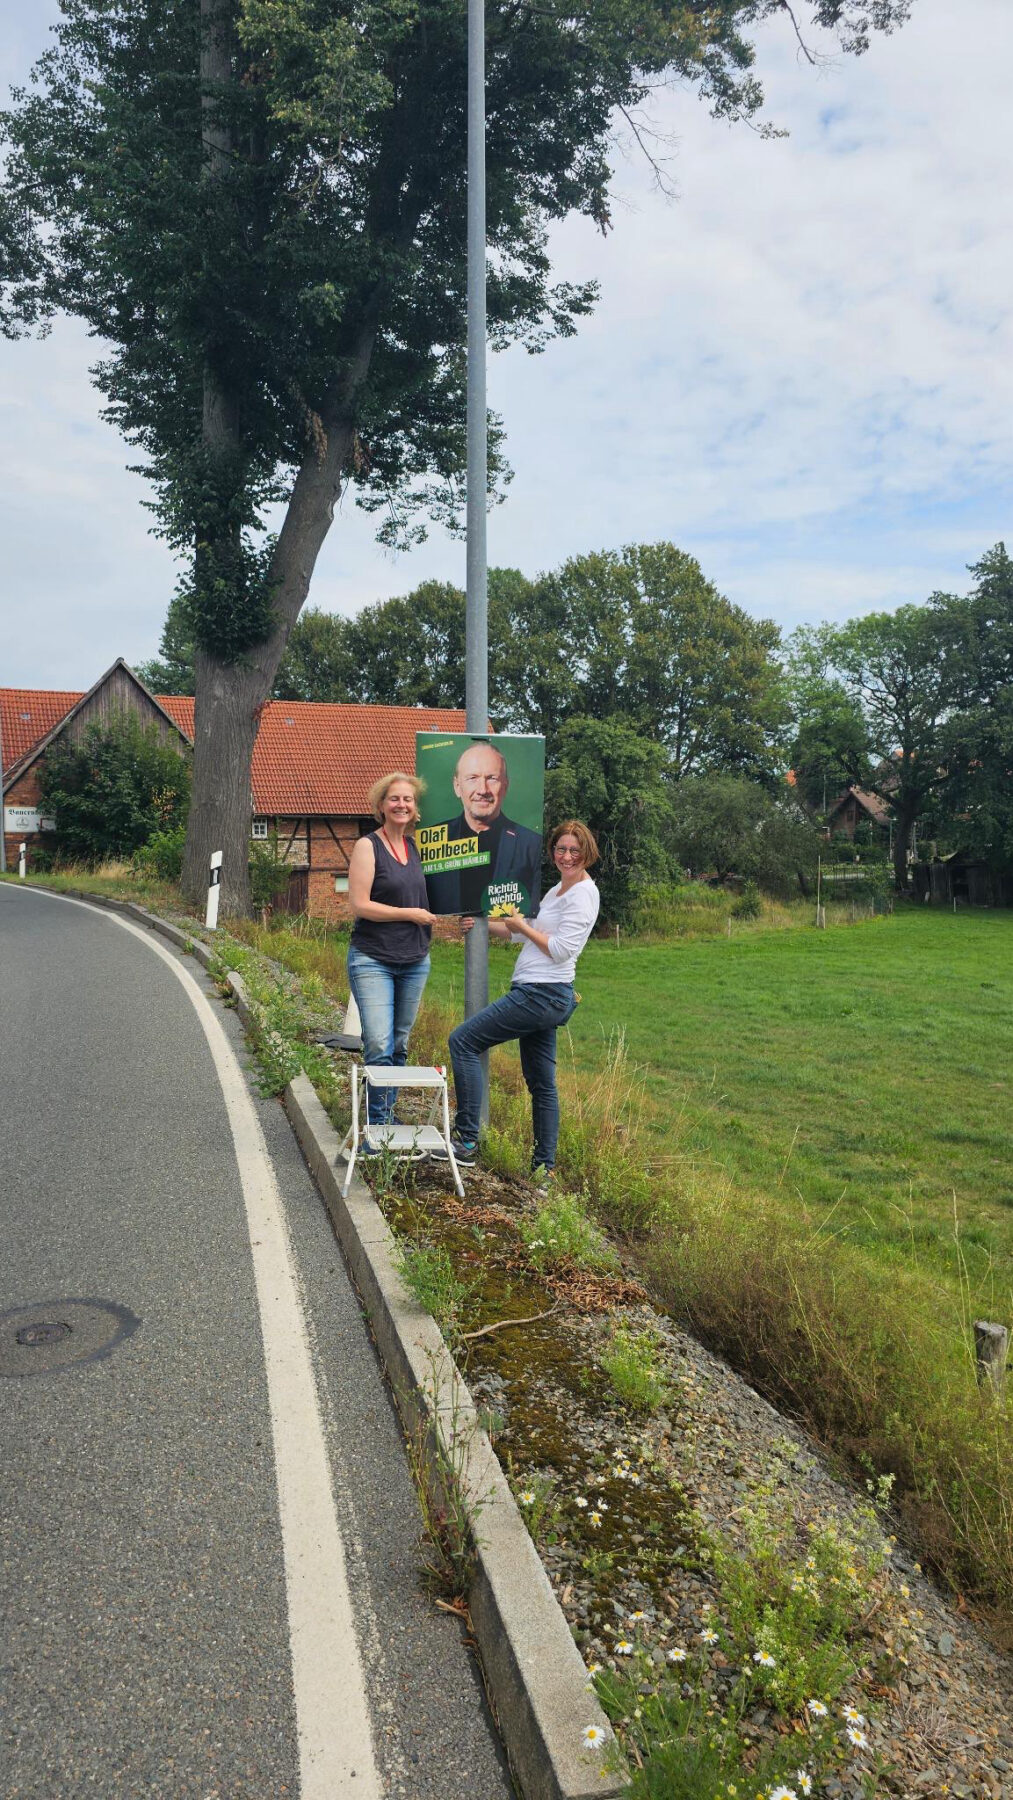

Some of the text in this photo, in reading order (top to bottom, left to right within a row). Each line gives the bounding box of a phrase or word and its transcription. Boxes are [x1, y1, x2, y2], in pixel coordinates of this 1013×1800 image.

[420, 827, 446, 845] Olaf
[420, 839, 476, 862] Horlbeck
[423, 864, 433, 873] AM
[434, 862, 444, 871] 1.9.
[488, 881, 519, 896] Richtig
[489, 891, 524, 906] wichtig.
